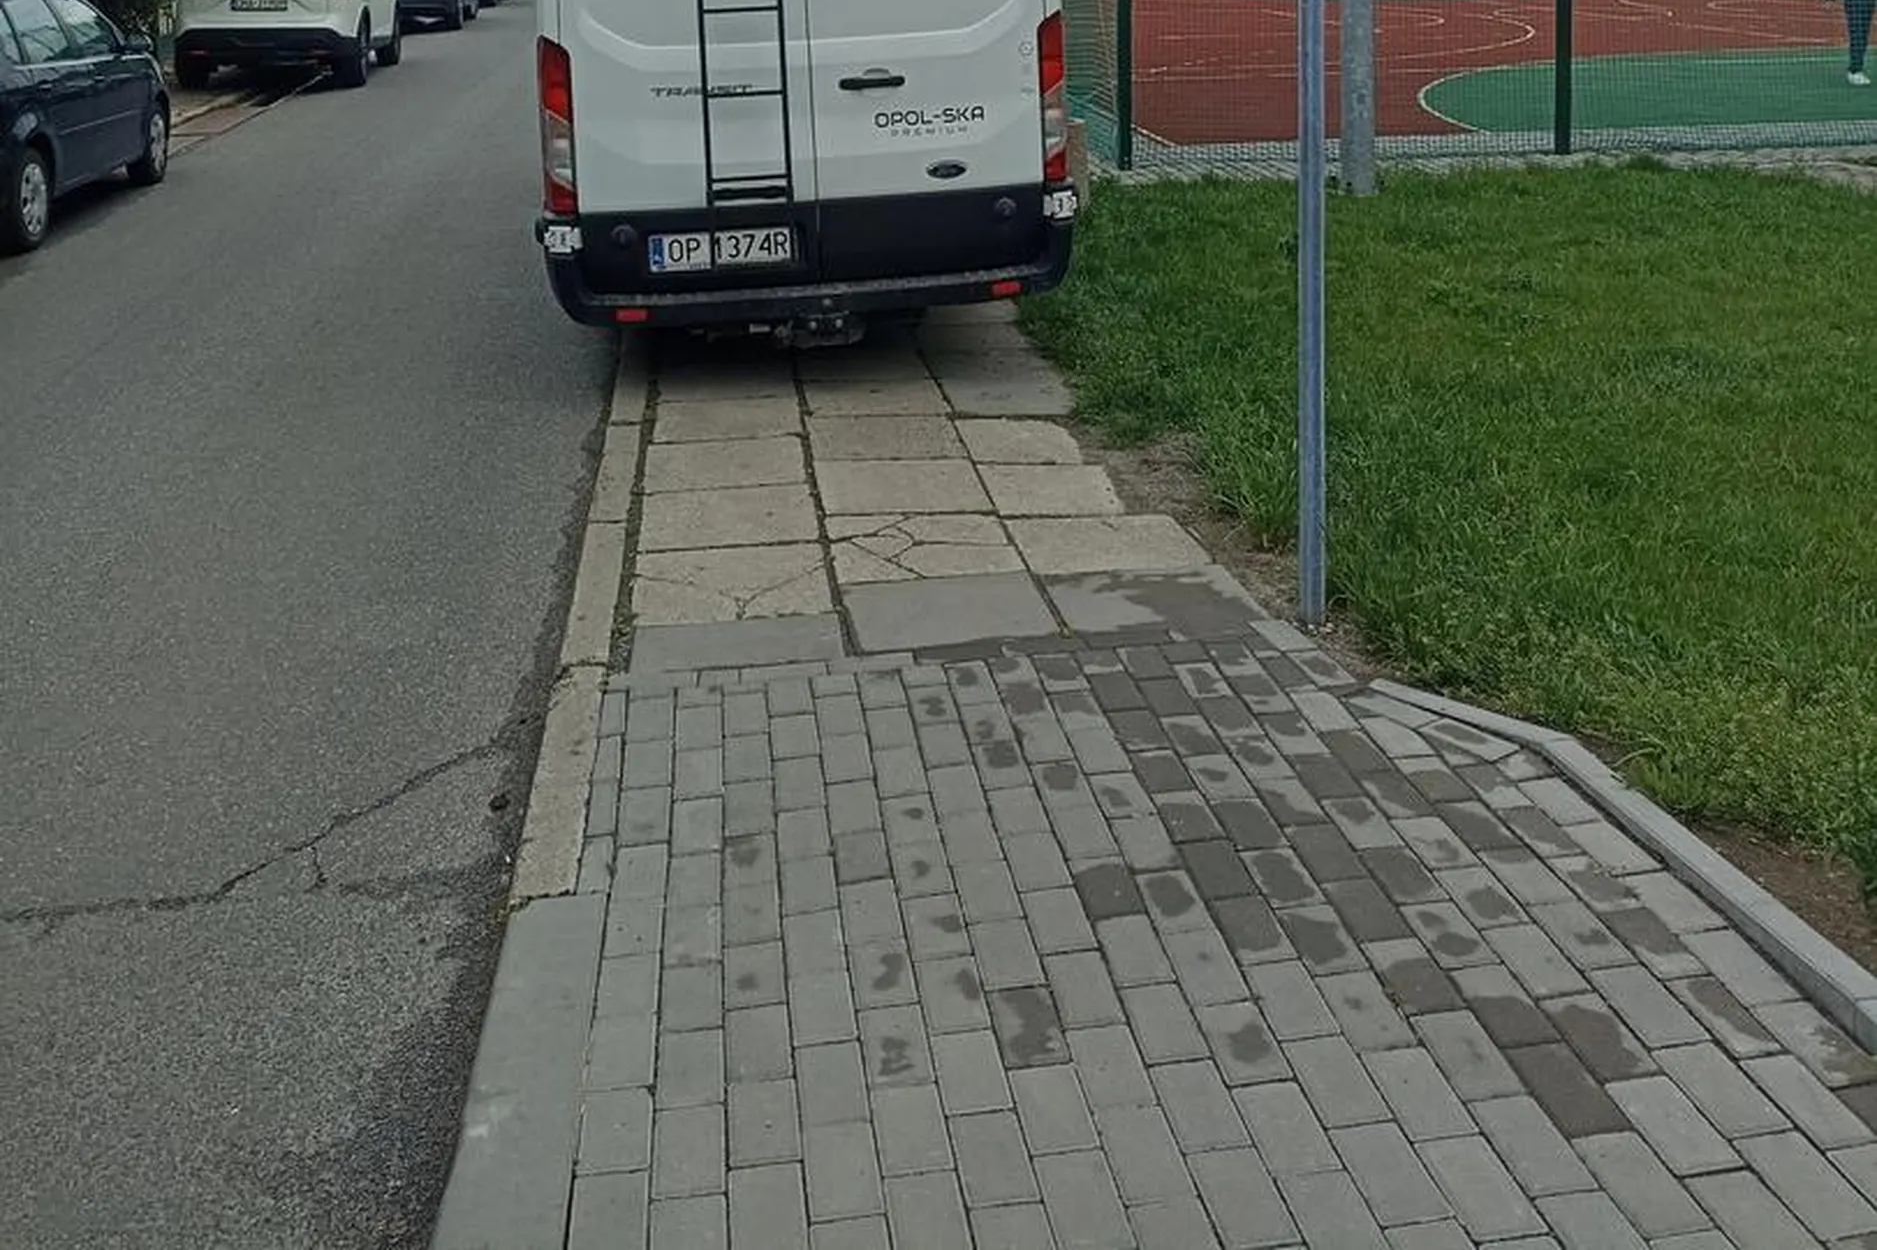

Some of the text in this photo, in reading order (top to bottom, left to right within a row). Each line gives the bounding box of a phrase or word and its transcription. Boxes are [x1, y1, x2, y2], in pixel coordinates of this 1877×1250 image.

[874, 105, 985, 129] OPOL-SKA
[668, 230, 788, 263] OP 1374R
